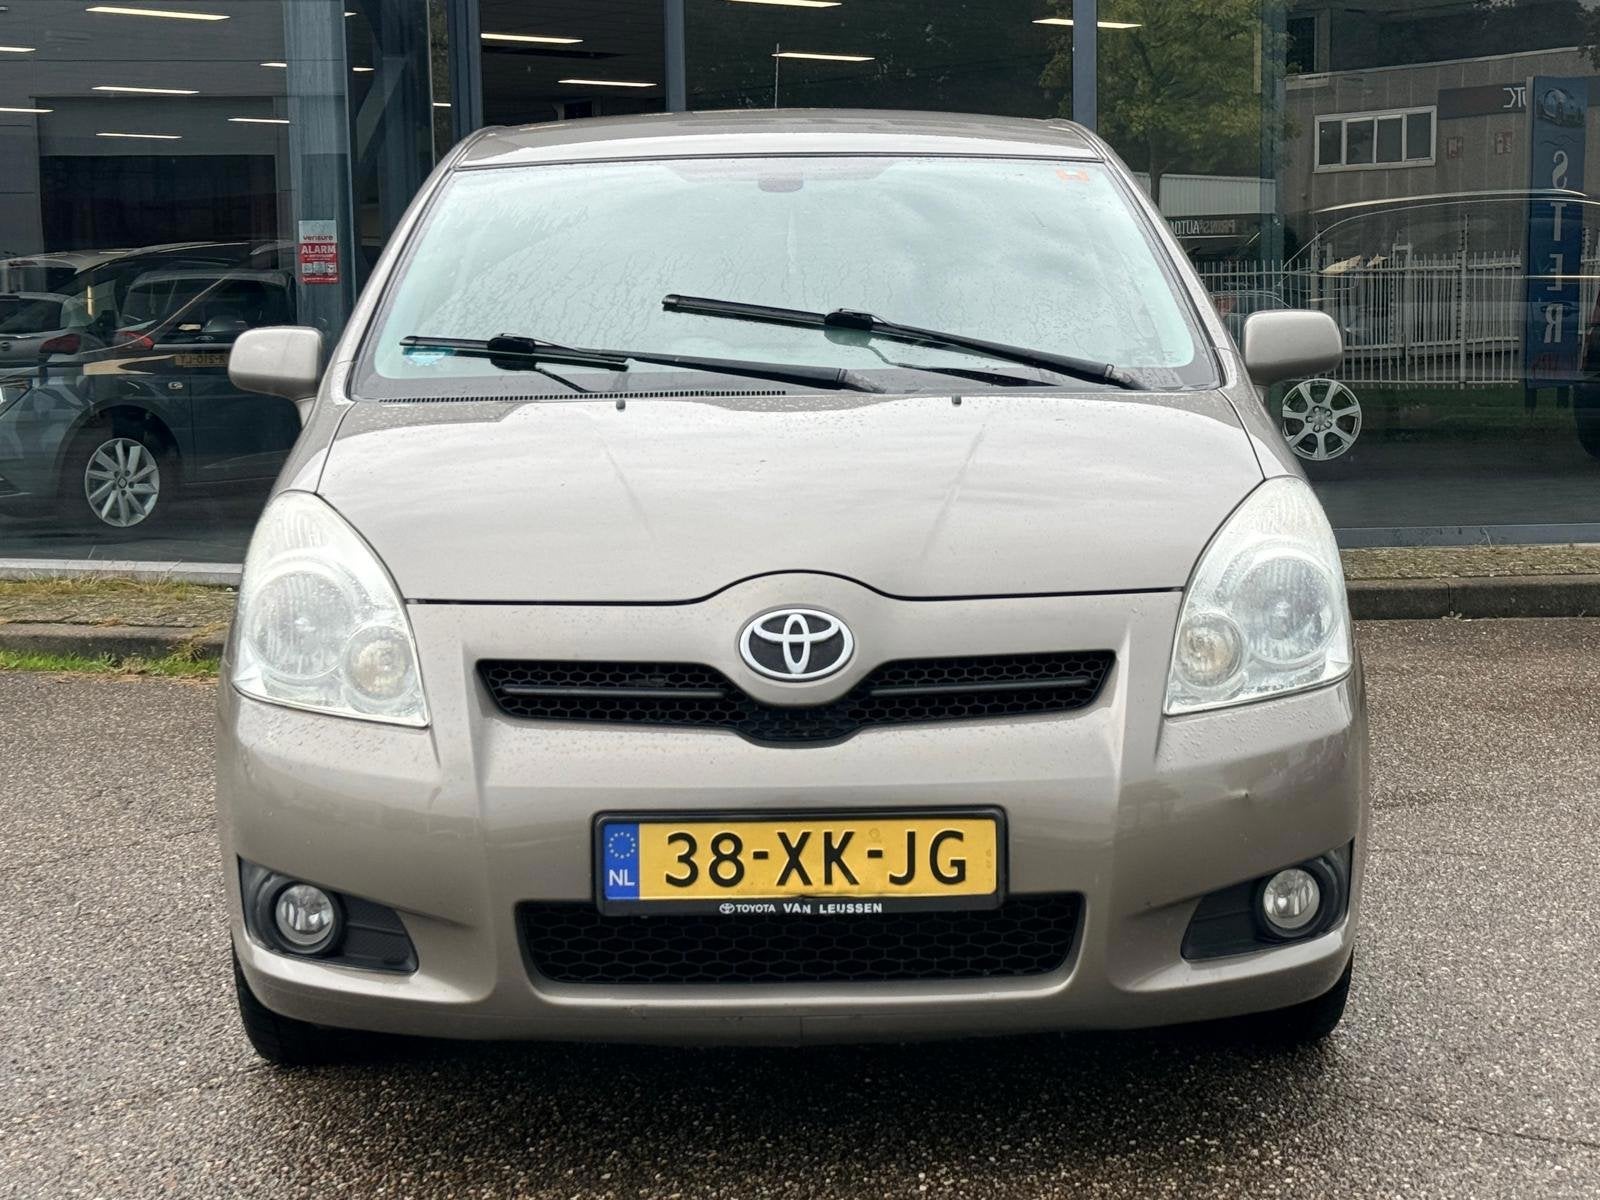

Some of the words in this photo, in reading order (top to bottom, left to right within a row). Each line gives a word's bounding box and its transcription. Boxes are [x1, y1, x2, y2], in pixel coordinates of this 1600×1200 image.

[301, 245, 337, 254] ALARM
[664, 829, 967, 888] 38-XK-JG
[608, 869, 635, 887] NL
[735, 903, 776, 914] TOYOTA
[783, 902, 812, 914] VAN
[819, 902, 883, 914] LEUSSEN
